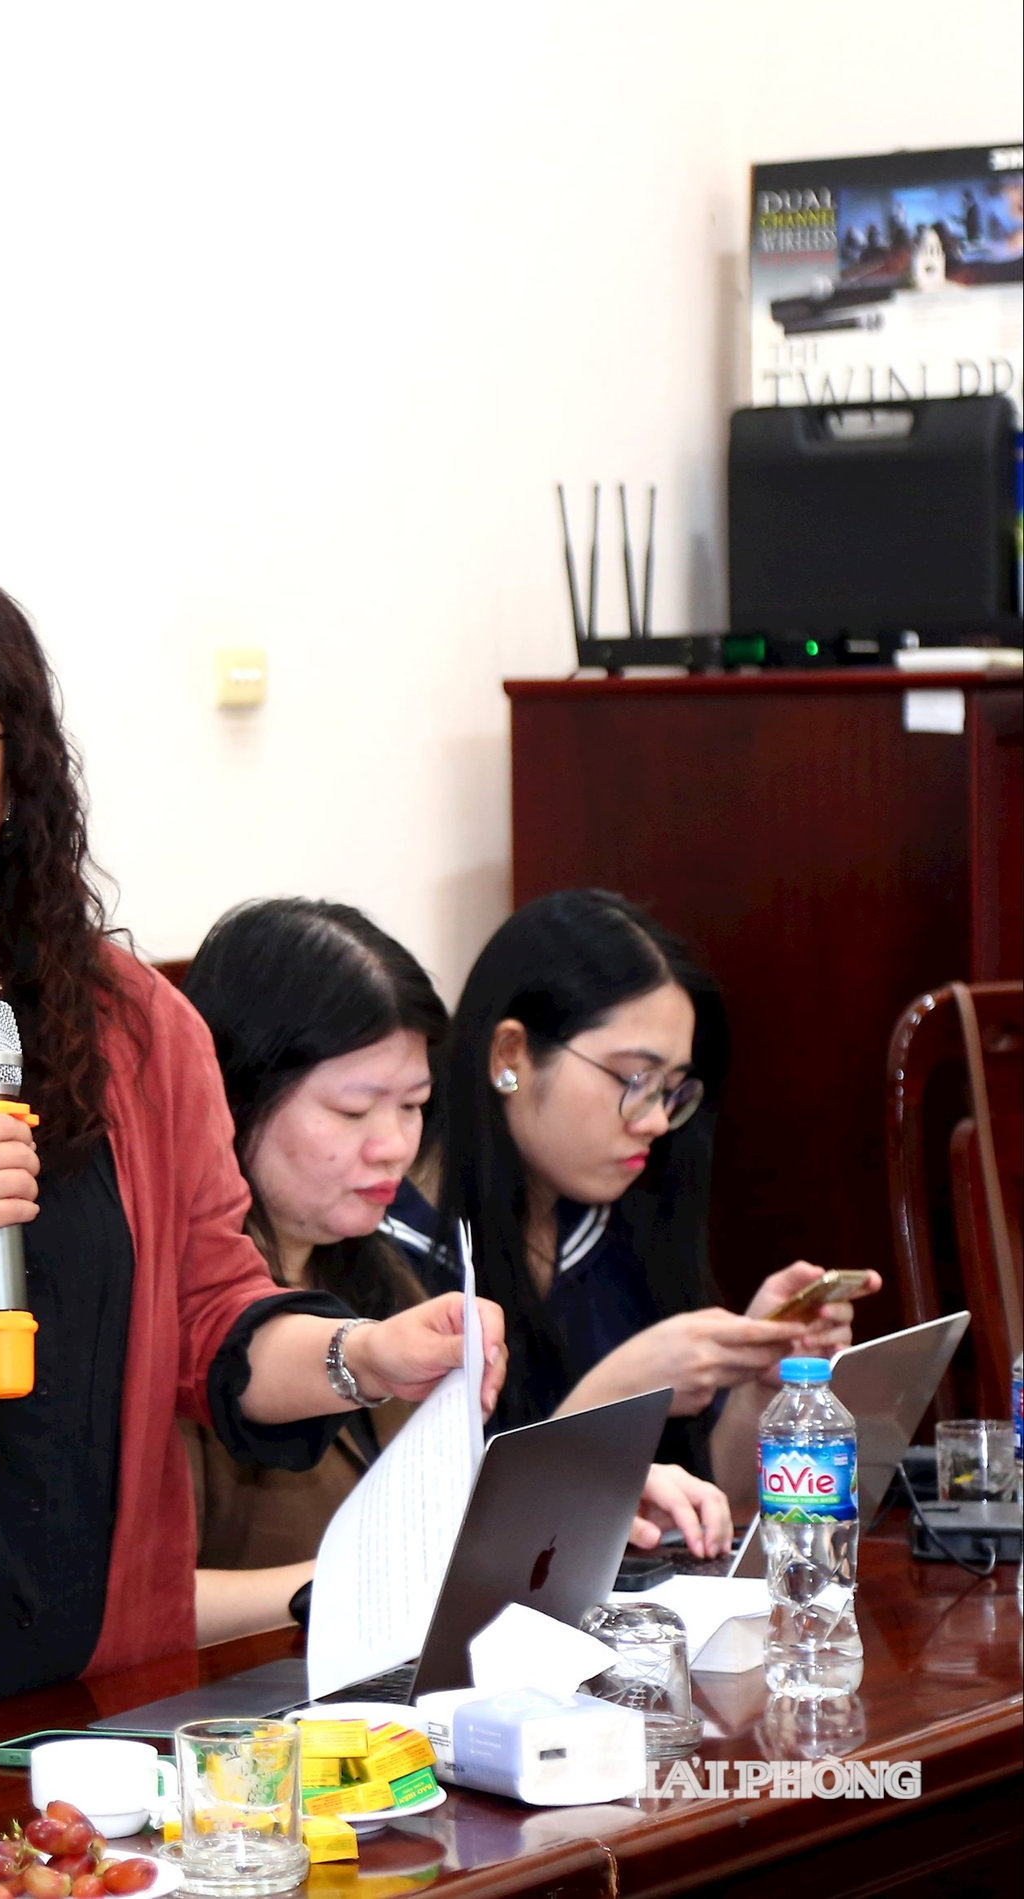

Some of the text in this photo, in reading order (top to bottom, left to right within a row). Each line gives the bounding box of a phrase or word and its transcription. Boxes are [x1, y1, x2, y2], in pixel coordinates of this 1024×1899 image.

[757, 187, 836, 213] DUAL
[763, 362, 931, 407] TWIN
[763, 1465, 835, 1494] laVie
